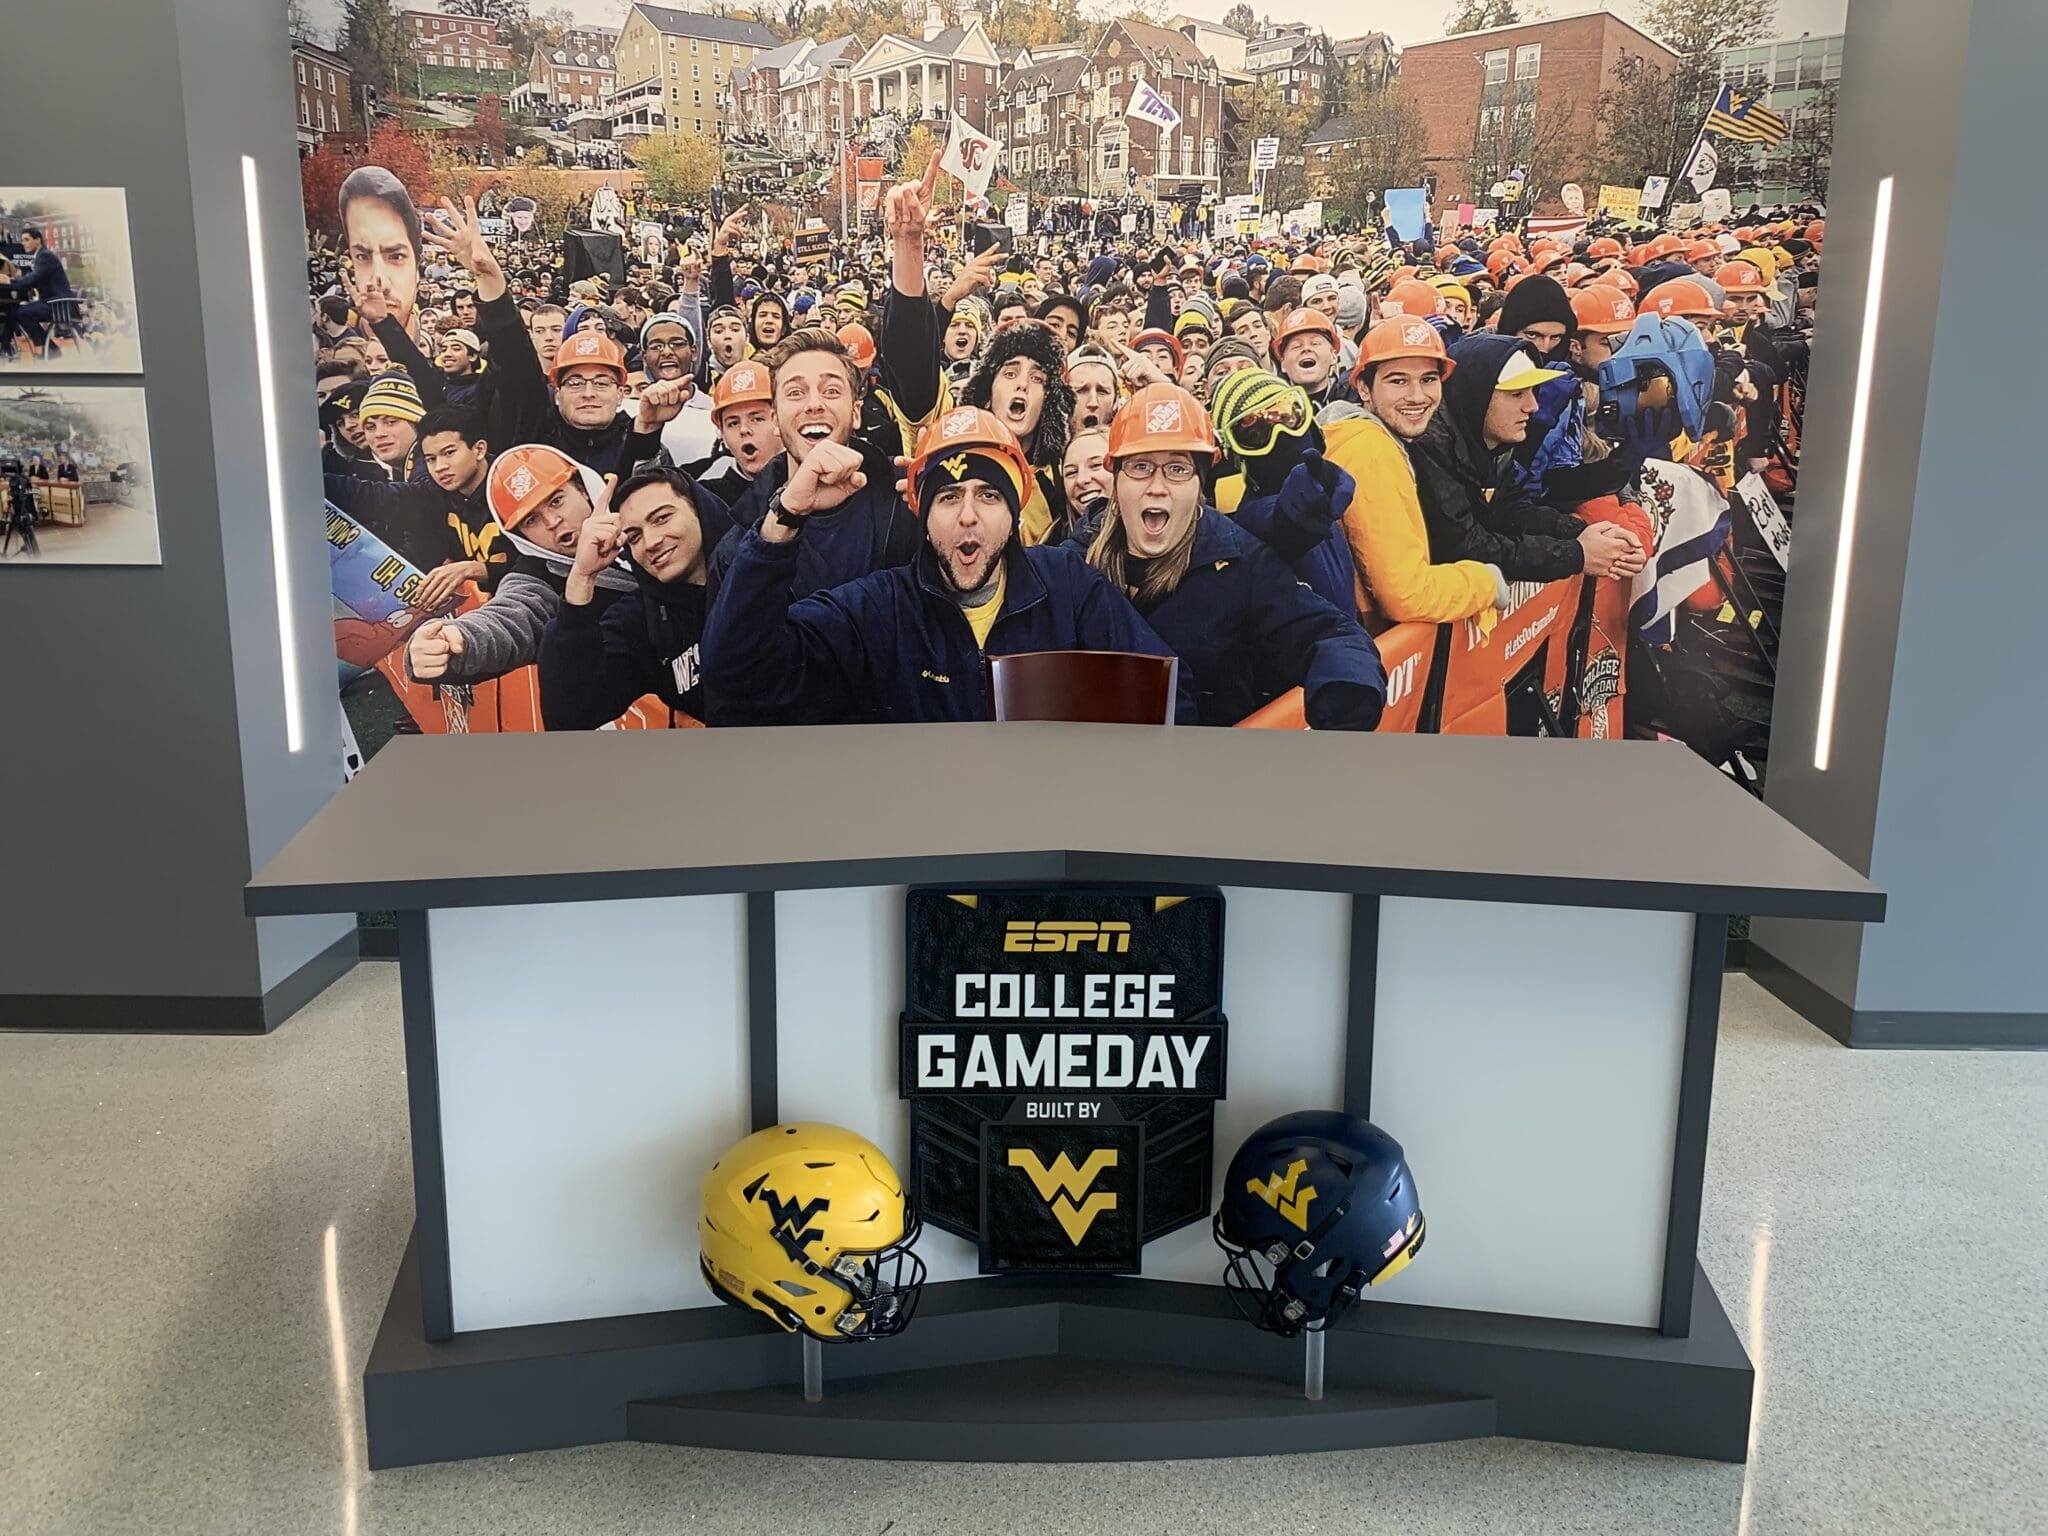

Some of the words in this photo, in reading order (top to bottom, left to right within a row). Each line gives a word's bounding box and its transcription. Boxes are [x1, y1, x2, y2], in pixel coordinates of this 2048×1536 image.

[1004, 921, 1131, 953] ESPN
[955, 973, 1176, 1018] COLLEGE
[918, 1033, 1211, 1089] GAMEDAY
[1026, 1102, 1074, 1119] BUILT
[1078, 1102, 1101, 1119] BY
